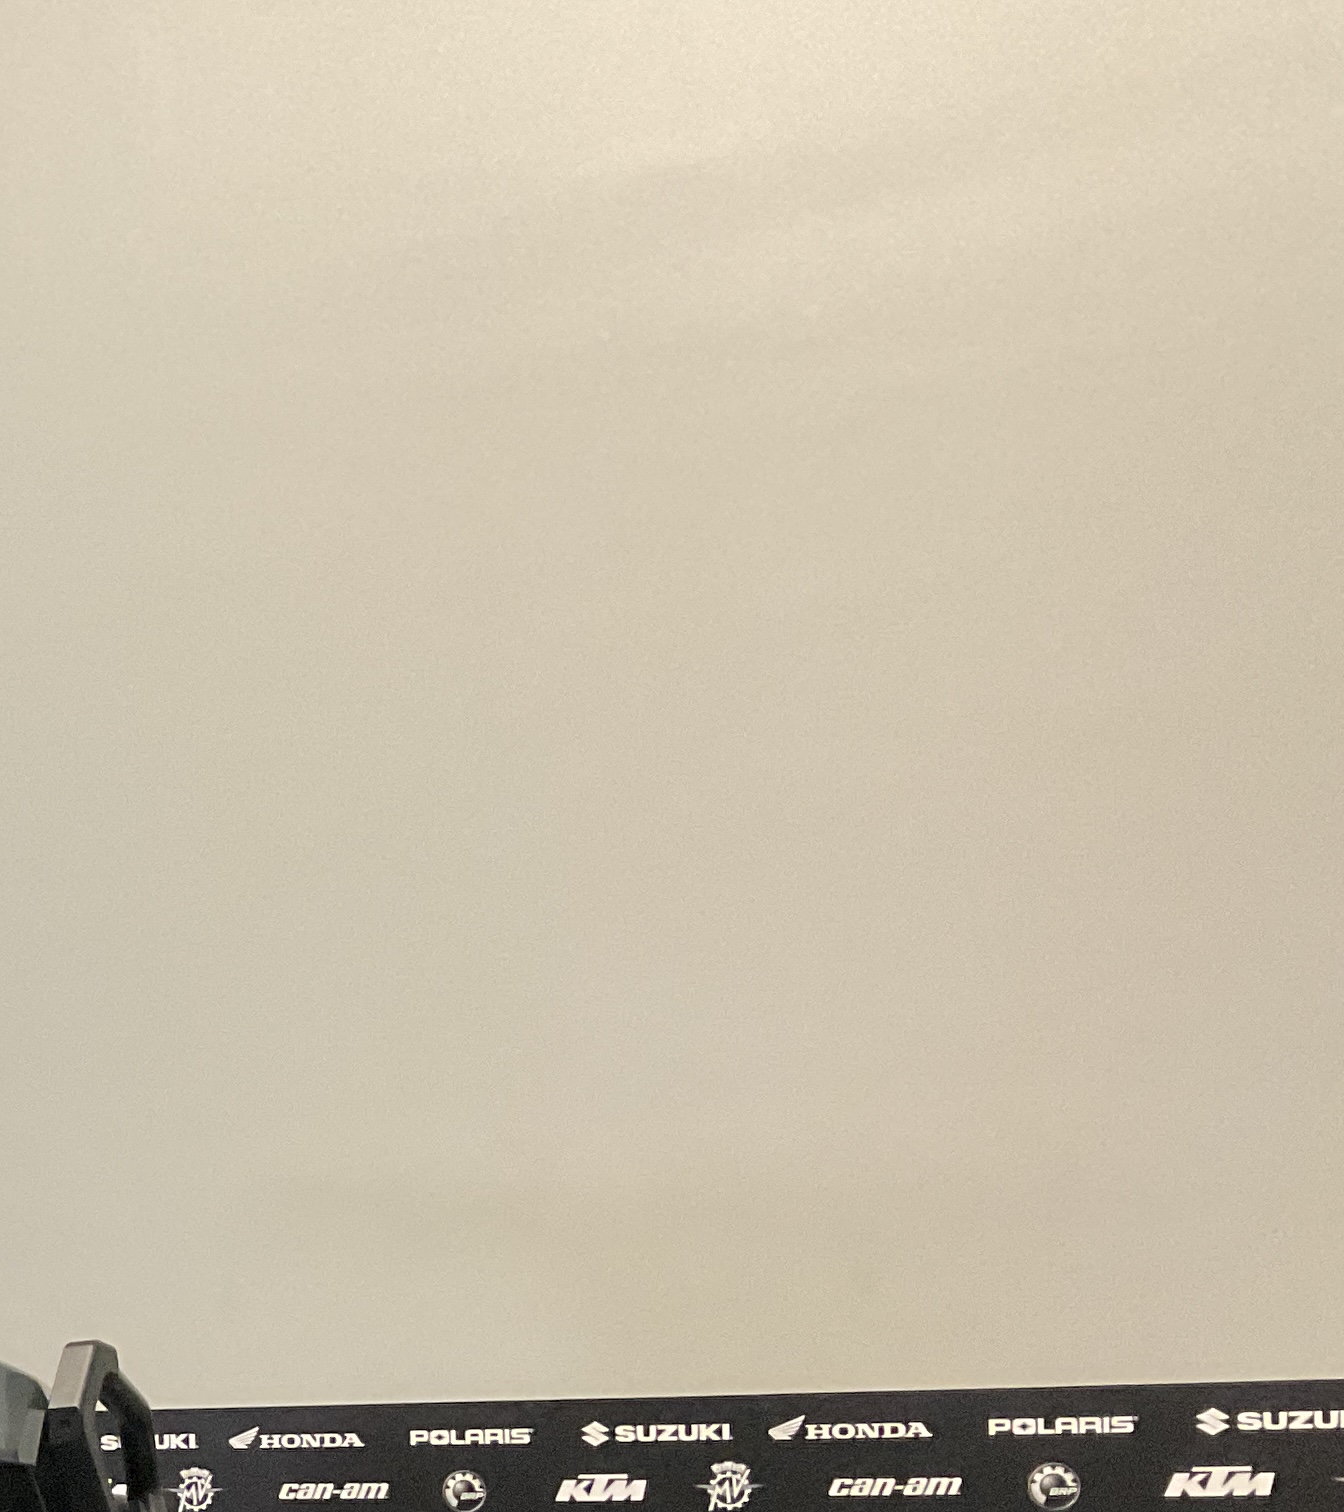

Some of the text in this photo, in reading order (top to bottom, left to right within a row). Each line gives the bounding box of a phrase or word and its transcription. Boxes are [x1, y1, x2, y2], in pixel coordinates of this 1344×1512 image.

[988, 1416, 1138, 1435] POLARIS
[1237, 1410, 1344, 1430] SUZU
[410, 1428, 533, 1445] POLARIS
[615, 1424, 733, 1442] SUZUKI
[805, 1422, 933, 1439] HONDA
[259, 1433, 365, 1448] HONDA
[556, 1474, 646, 1501] KTM
[828, 1477, 962, 1496] can-am
[1164, 1466, 1275, 1497] KTM
[279, 1483, 389, 1499] can-am
